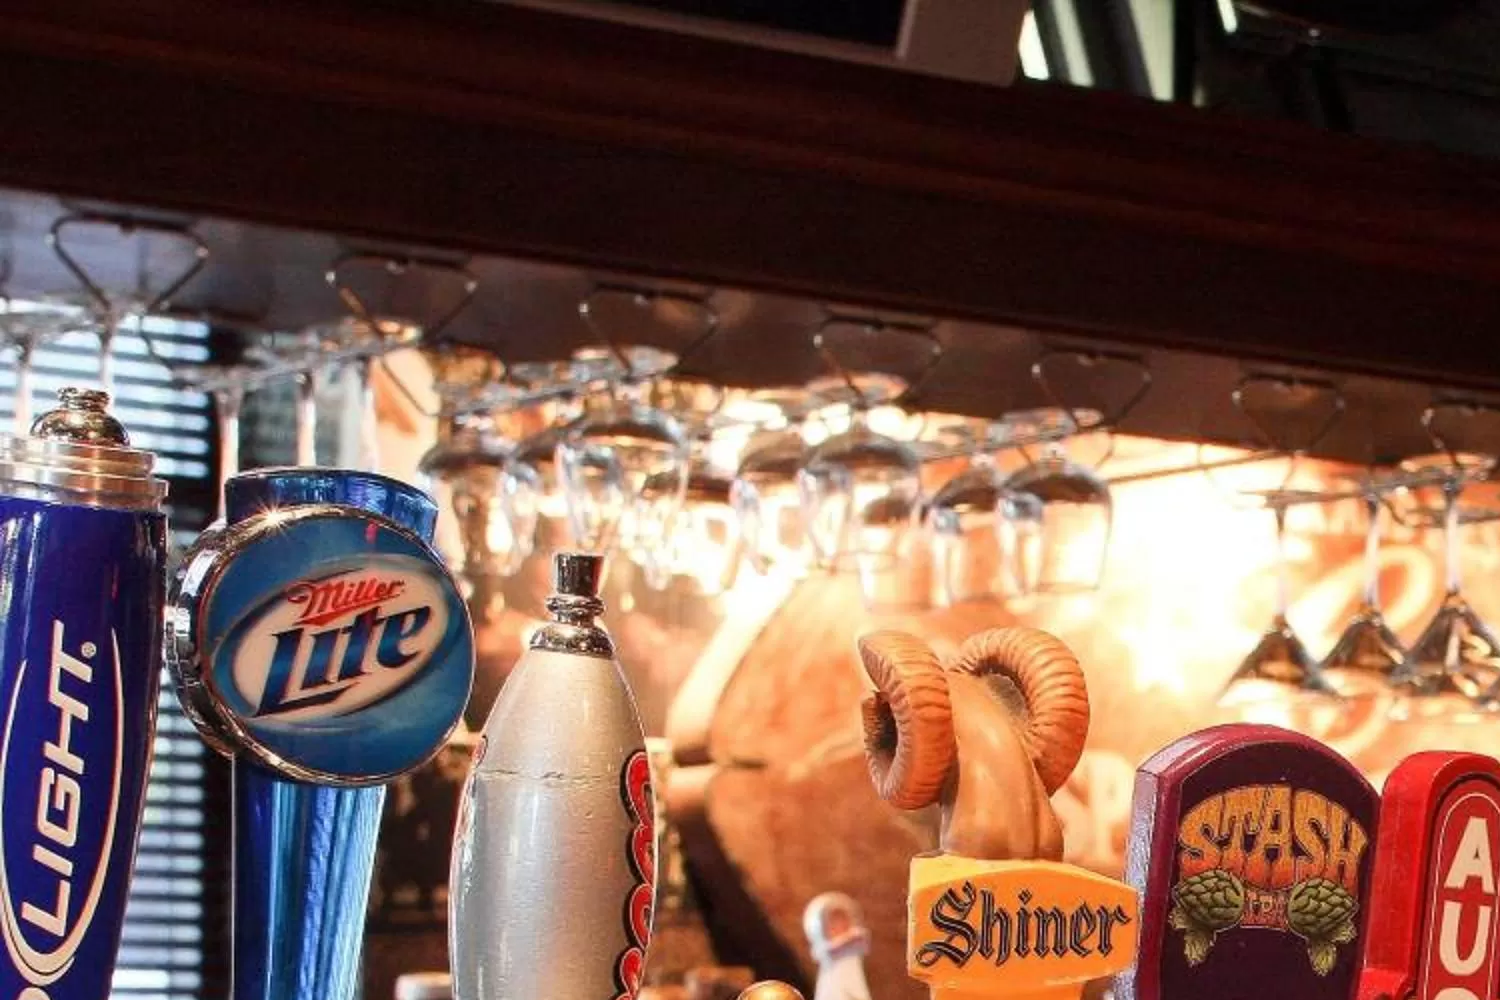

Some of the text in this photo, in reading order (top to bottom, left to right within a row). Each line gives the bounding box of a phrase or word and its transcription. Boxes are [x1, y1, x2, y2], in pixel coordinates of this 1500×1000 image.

[287, 577, 403, 624] Miller
[252, 605, 432, 718] Lite
[21, 619, 94, 939] LIGHT
[1178, 784, 1369, 893] STASH
[915, 879, 1133, 970] Shiner
